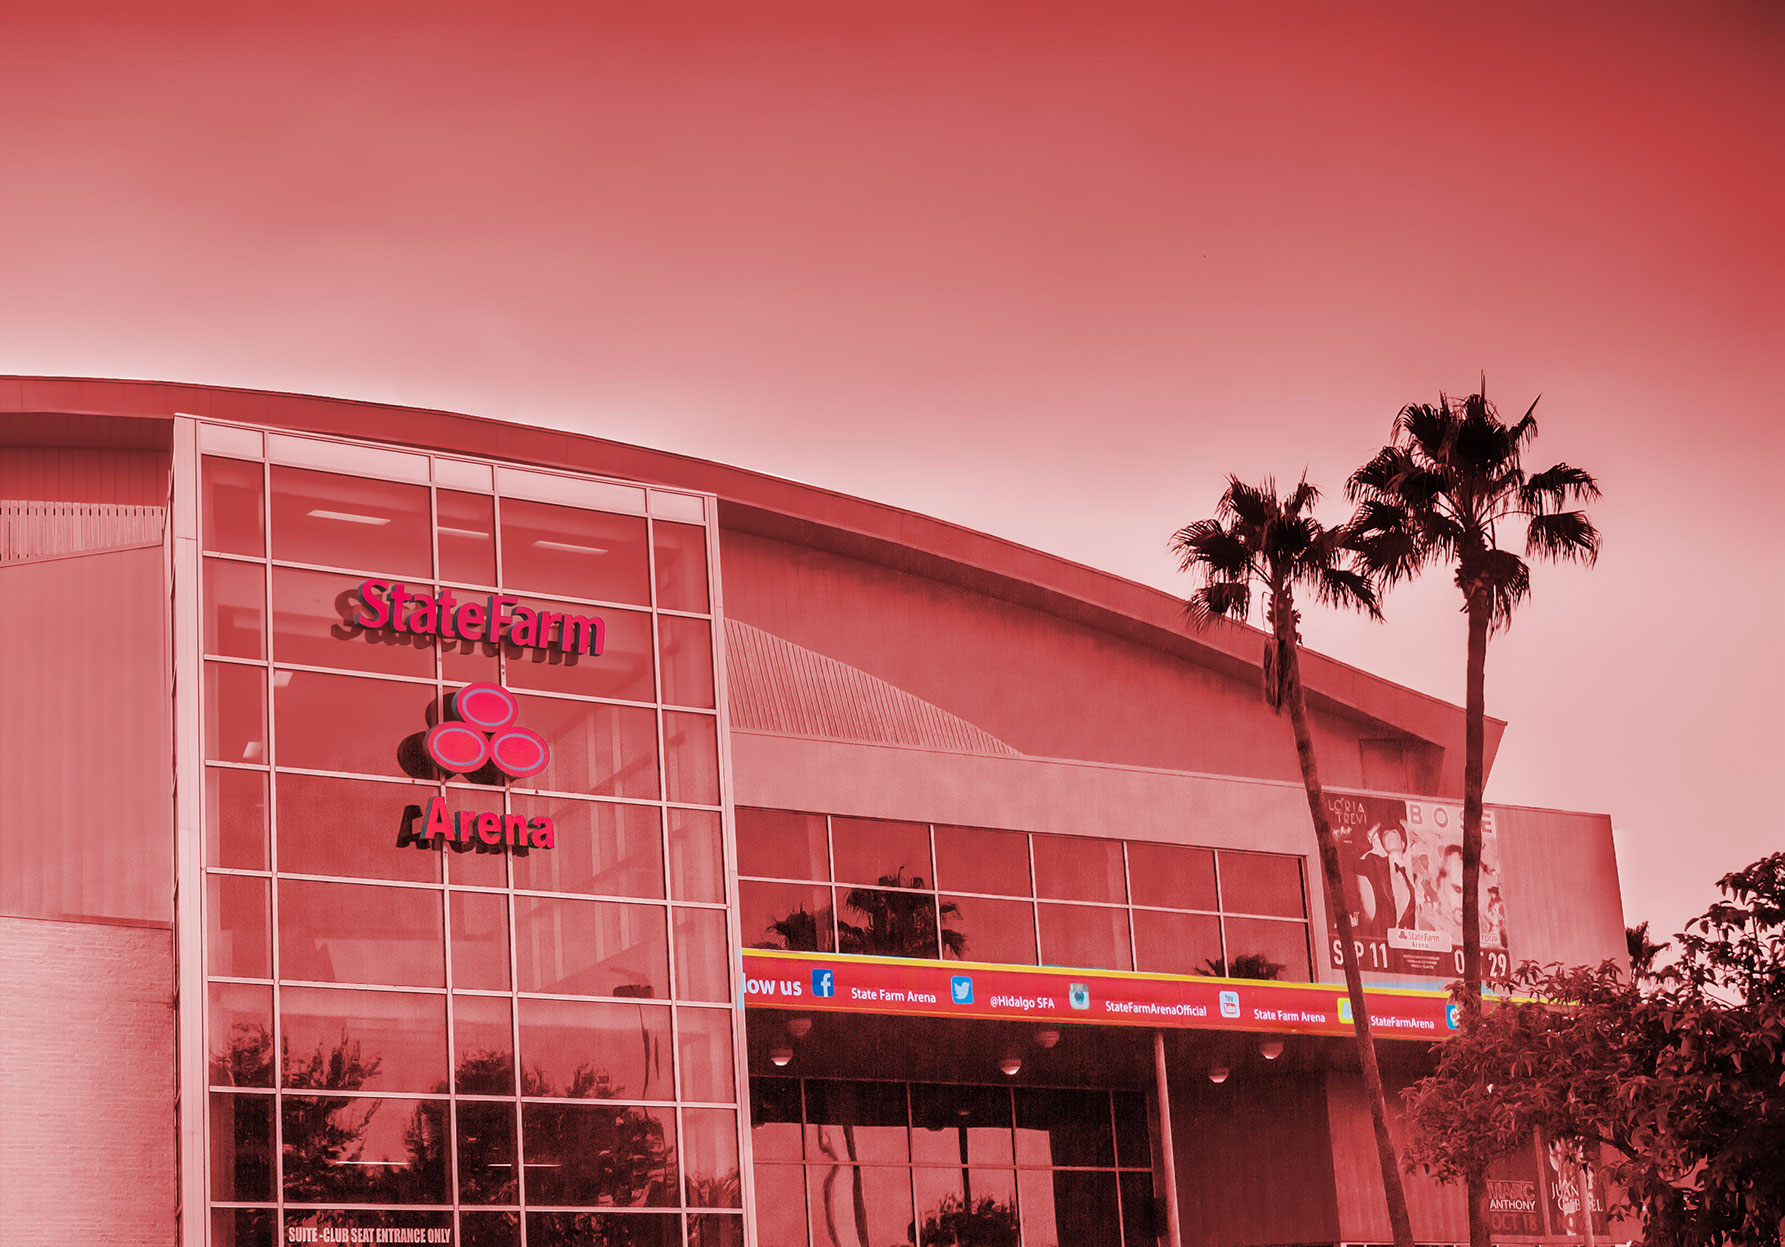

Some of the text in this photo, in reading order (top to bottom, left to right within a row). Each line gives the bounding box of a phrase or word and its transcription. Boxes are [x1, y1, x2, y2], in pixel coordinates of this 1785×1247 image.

[355, 579, 605, 656] StateFarm
[1327, 797, 1365, 814] LORIA
[421, 796, 555, 849] Arena
[1335, 812, 1367, 825] TREVI
[1410, 804, 1492, 833] BOE
[1332, 939, 1388, 969] SP 11
[1488, 952, 1507, 978] 29
[780, 980, 802, 996] us
[851, 987, 937, 1003] State Farm Arena
[990, 996, 1055, 1010] @Hidalgo SFA
[1105, 1001, 1207, 1017] StateFarmArenaOfficial
[1254, 1008, 1326, 1023] State Farm Arena
[1370, 1015, 1435, 1029] StateFarmArena
[1486, 1182, 1536, 1200] MARC
[1489, 1199, 1536, 1210] ANTHONY
[288, 1227, 318, 1243] SUITE
[351, 1228, 374, 1243] SEAT
[376, 1228, 426, 1243] ENTRANCE
[427, 1228, 451, 1244] ONLY
